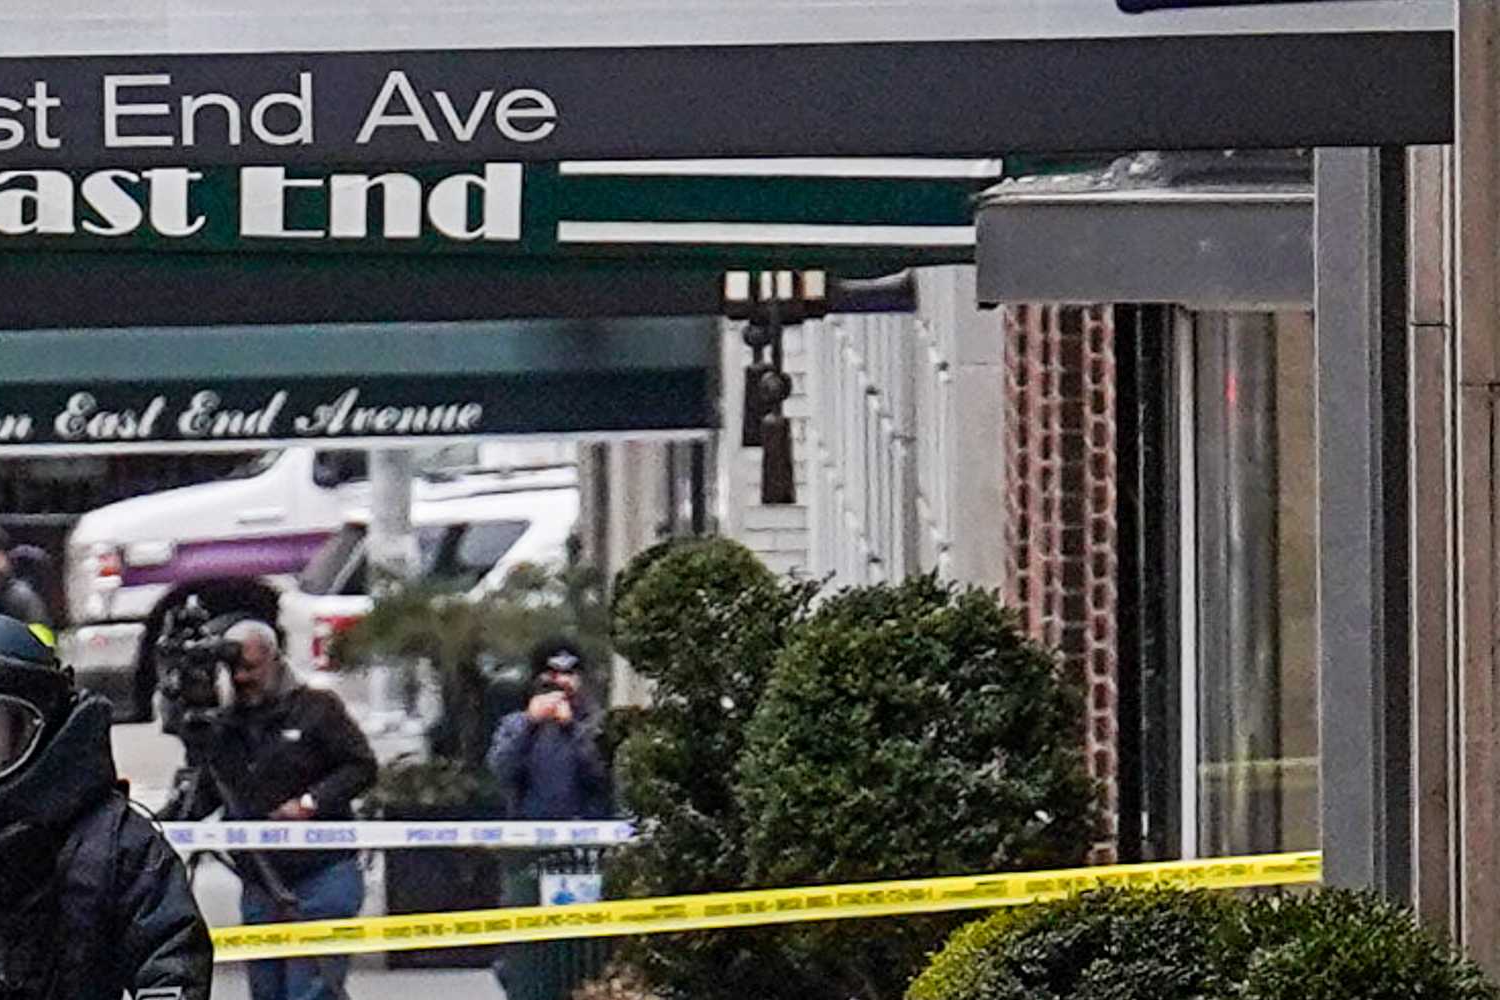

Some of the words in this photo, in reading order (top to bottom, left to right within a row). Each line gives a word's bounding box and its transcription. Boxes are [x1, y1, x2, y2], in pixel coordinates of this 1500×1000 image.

[103, 71, 314, 148] End
[355, 69, 558, 144] Ave
[239, 161, 523, 241] End
[53, 391, 166, 436] East
[176, 389, 288, 434] End
[294, 387, 484, 432] Avenue
